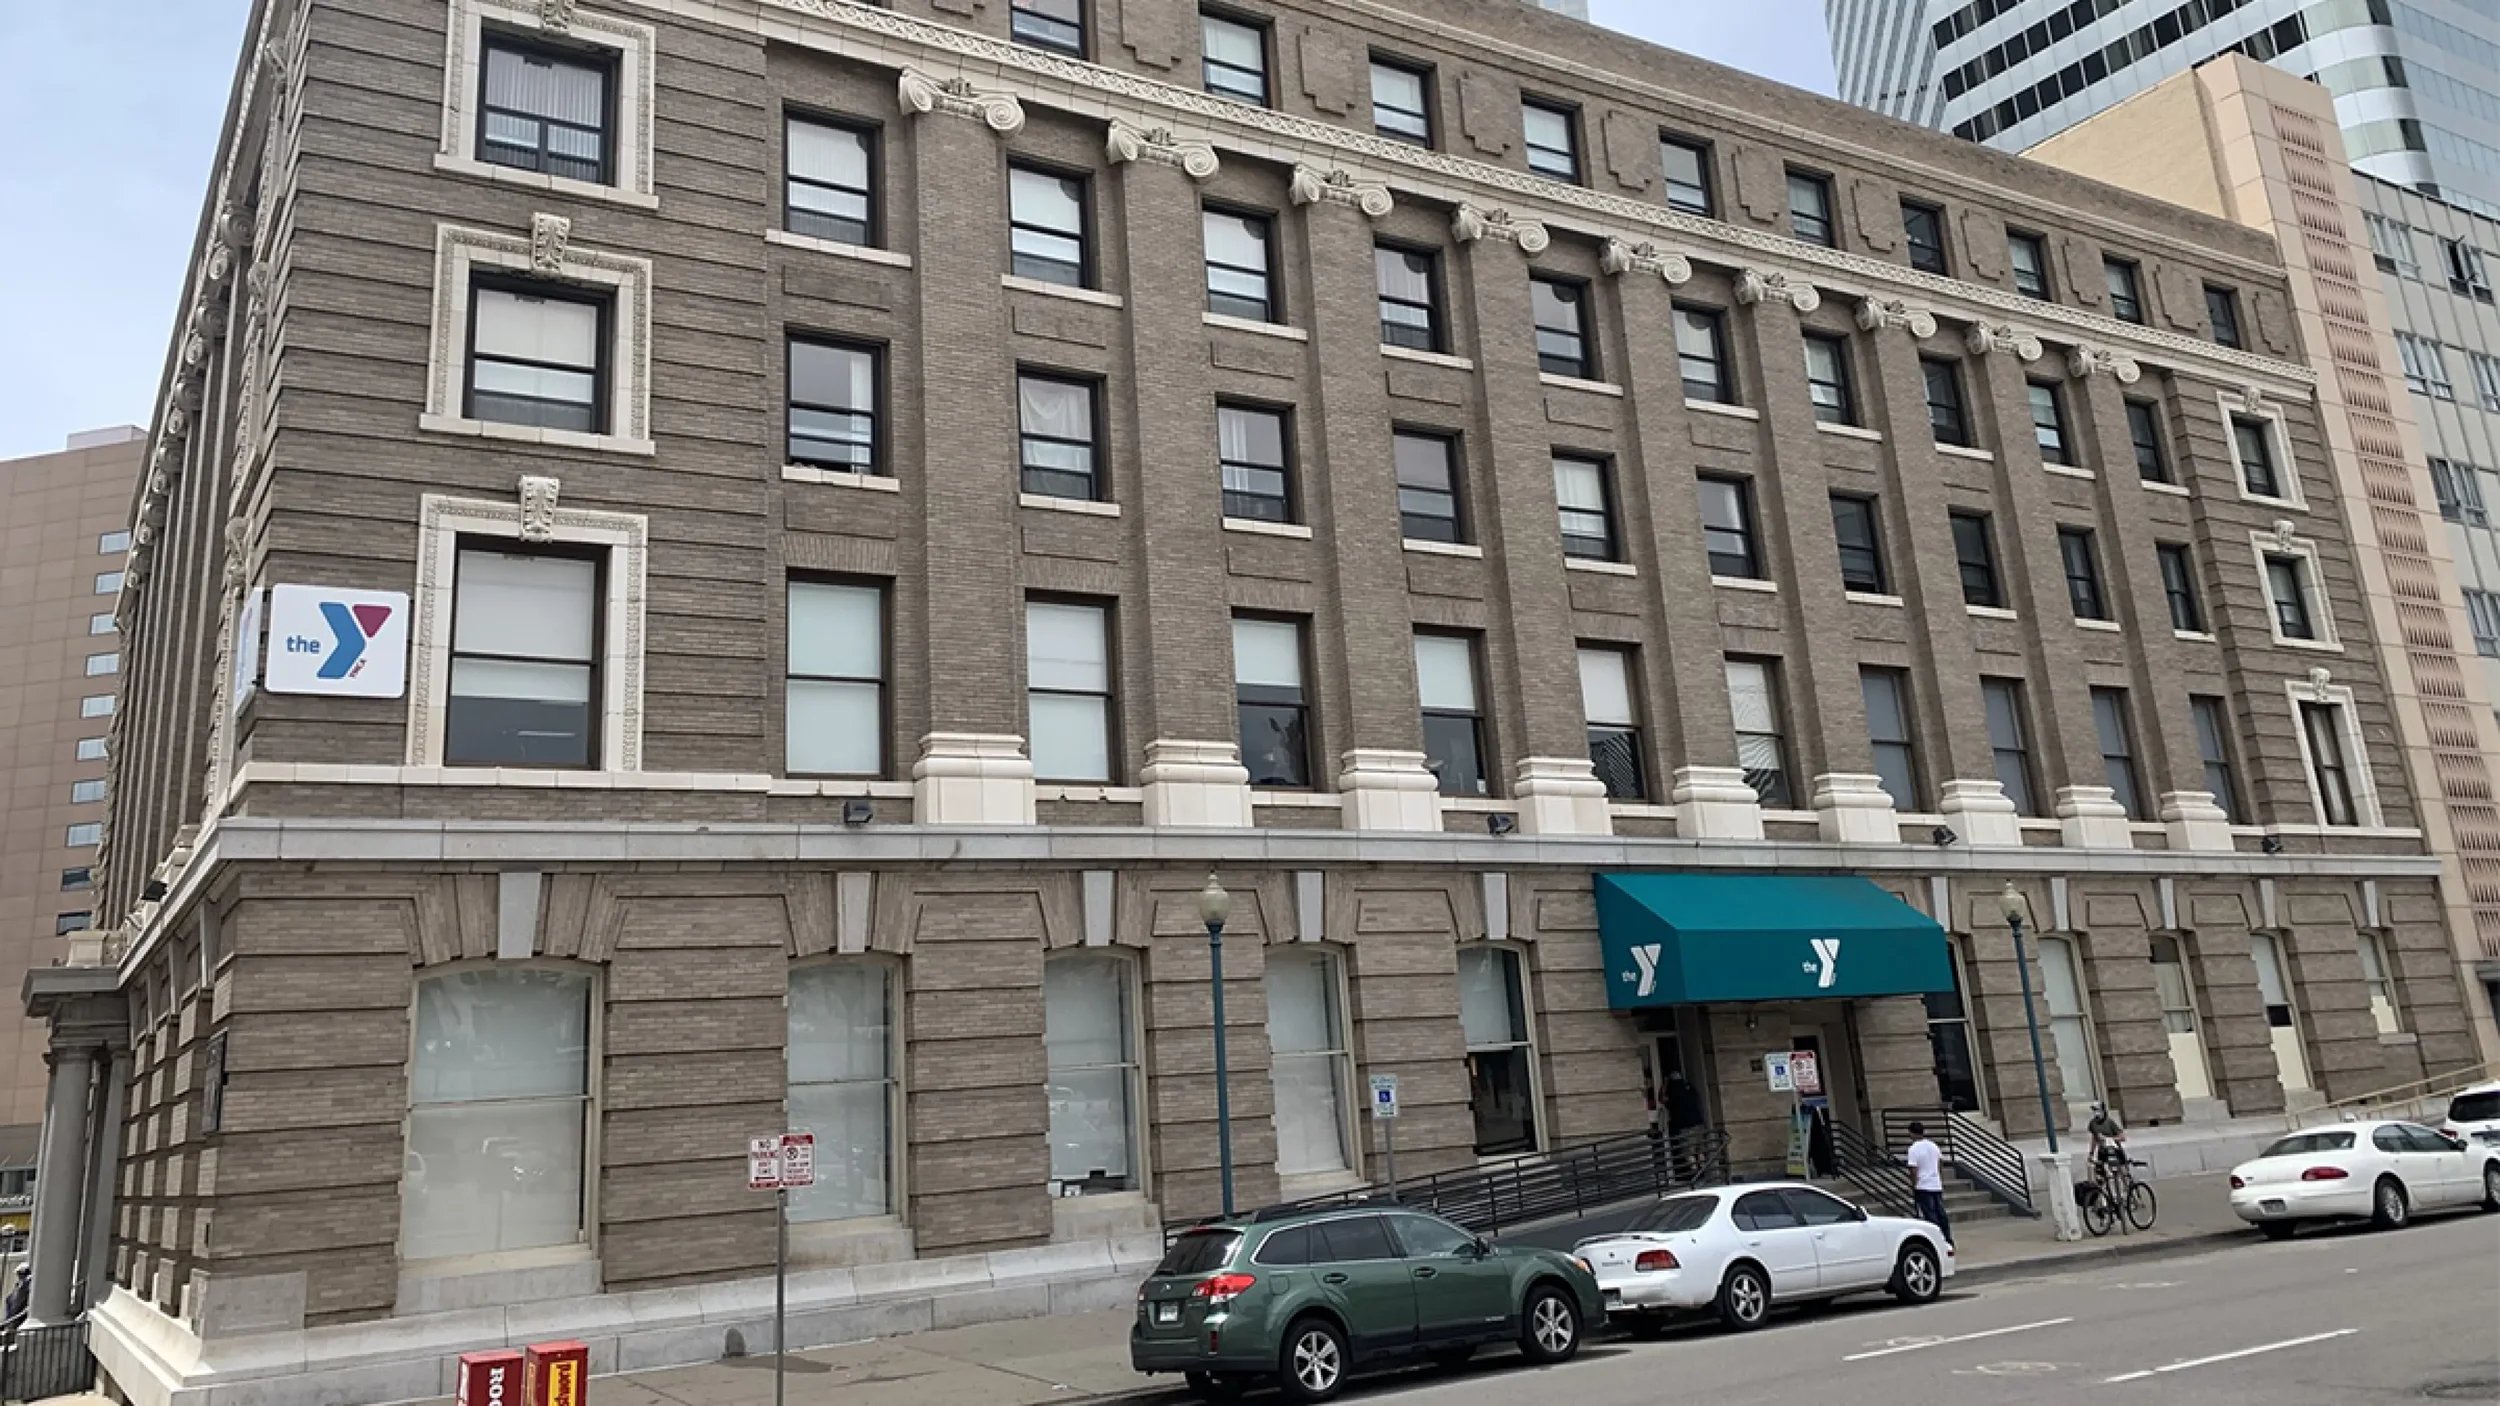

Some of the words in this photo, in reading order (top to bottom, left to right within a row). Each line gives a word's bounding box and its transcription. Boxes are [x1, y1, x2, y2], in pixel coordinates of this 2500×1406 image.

[286, 635, 320, 653] the
[317, 602, 392, 679] Y
[1621, 970, 1637, 983] the
[1630, 943, 1662, 997] Y
[1802, 961, 1818, 974] the
[1810, 938, 1841, 988] Y
